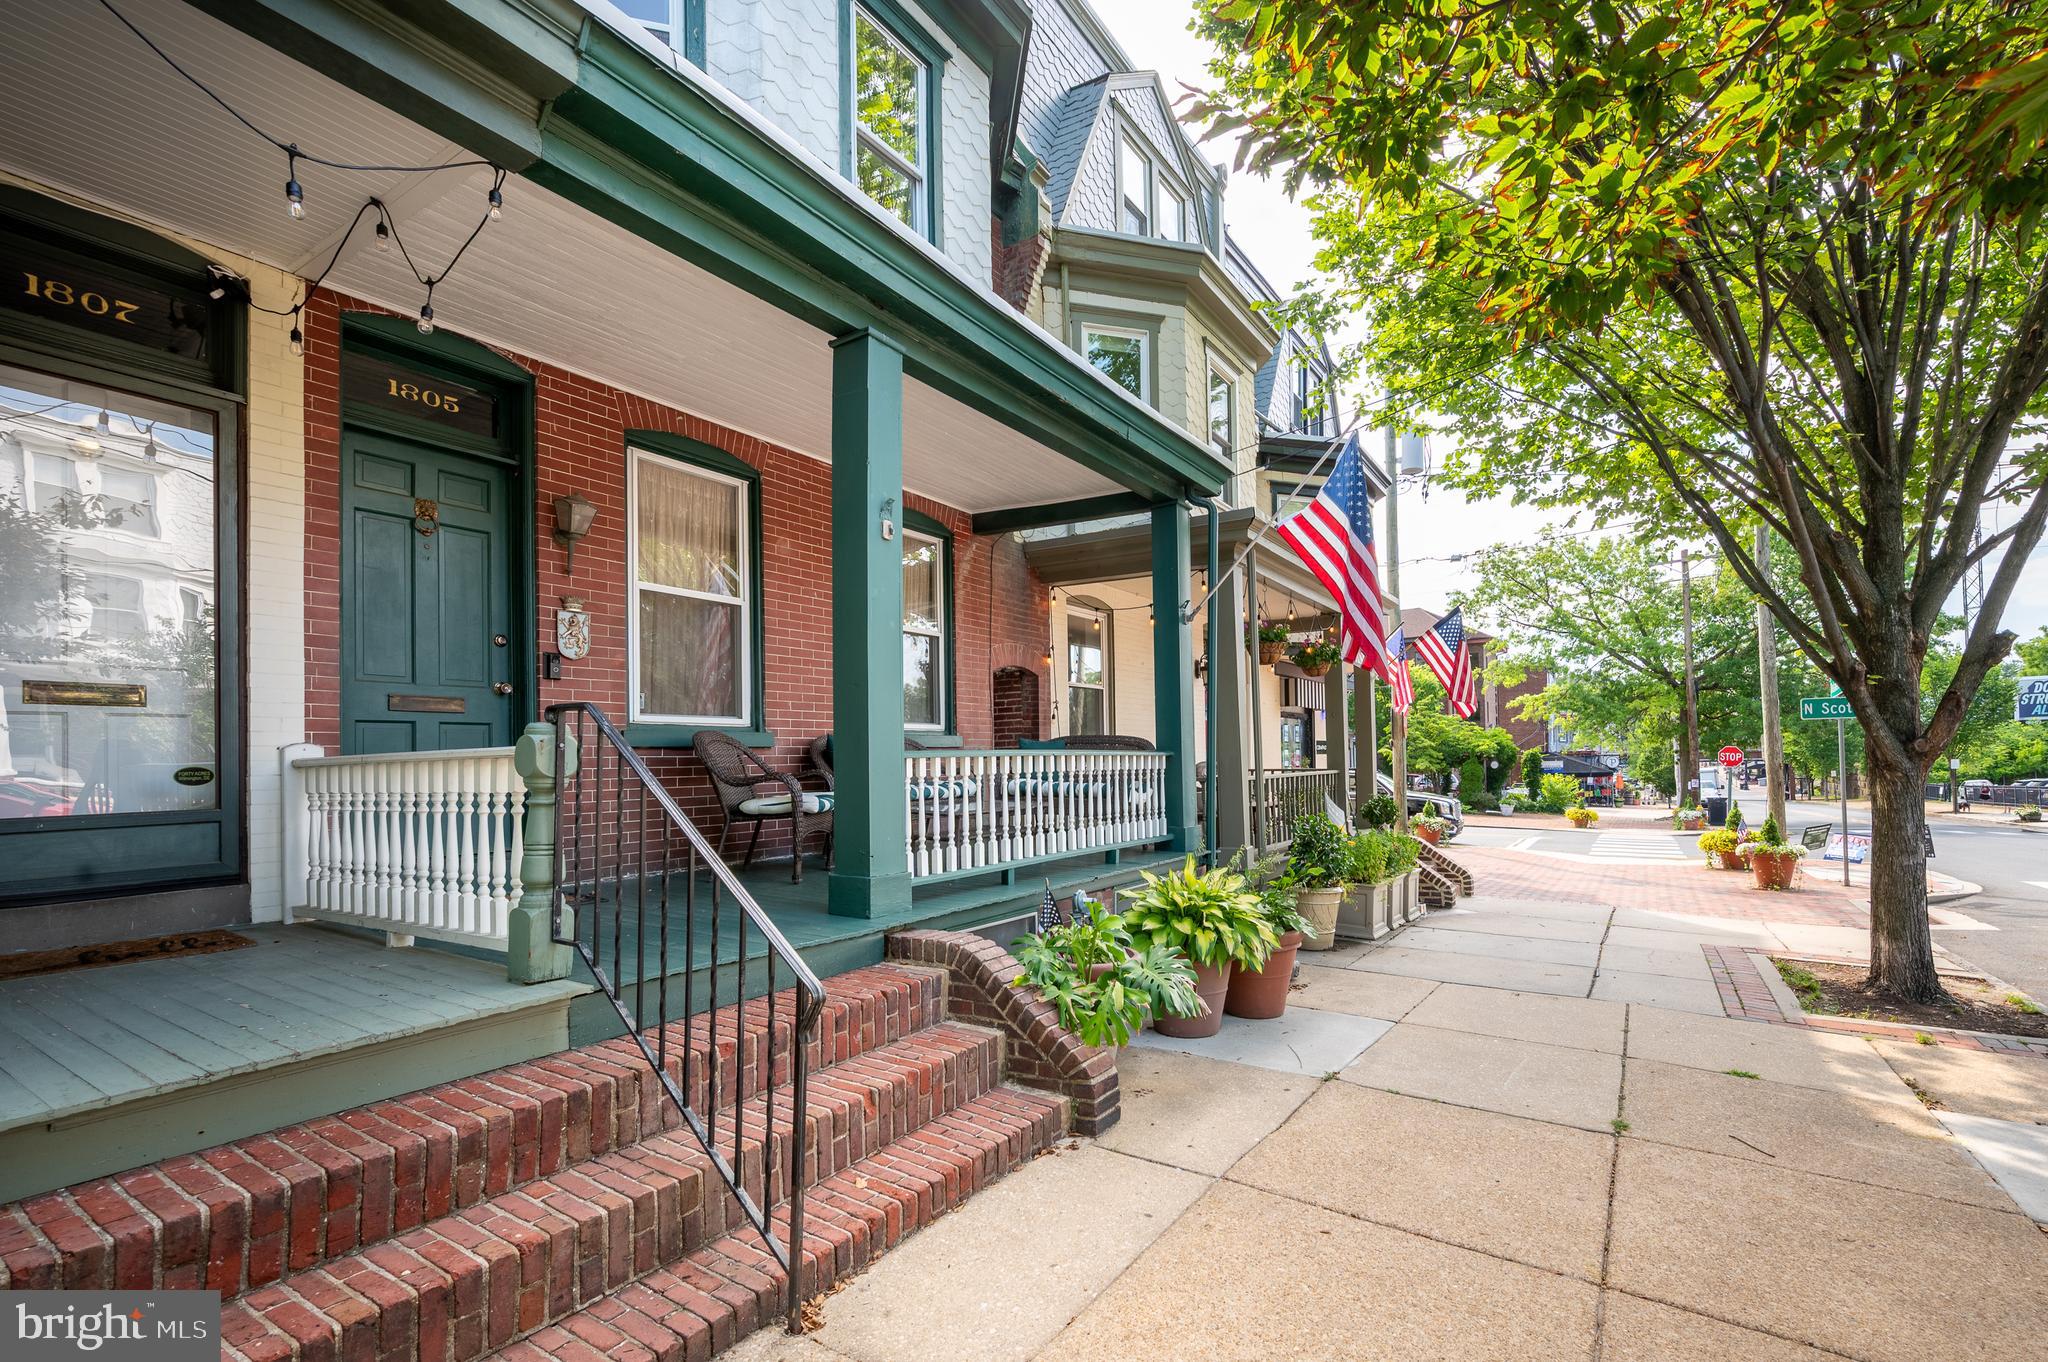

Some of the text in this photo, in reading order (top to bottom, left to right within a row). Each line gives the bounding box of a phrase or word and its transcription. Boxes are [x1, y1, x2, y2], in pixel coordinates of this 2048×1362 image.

[23, 272, 140, 325] 1807
[387, 378, 460, 413] 1805
[1804, 703, 1813, 715] N
[1720, 752, 1742, 761] STOP
